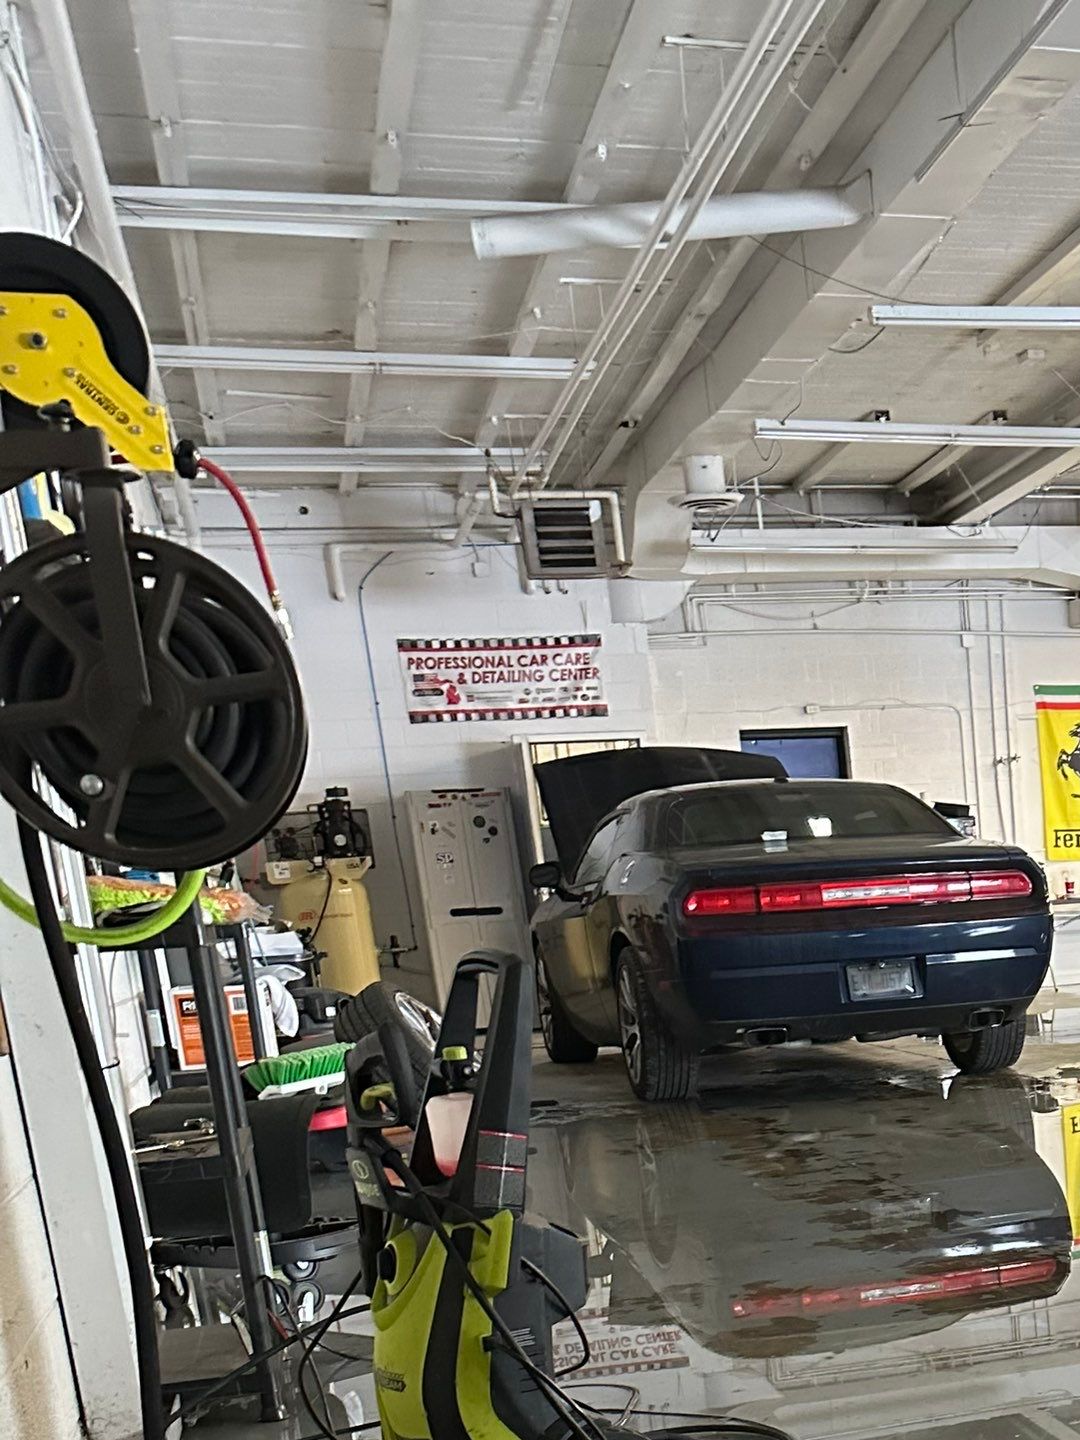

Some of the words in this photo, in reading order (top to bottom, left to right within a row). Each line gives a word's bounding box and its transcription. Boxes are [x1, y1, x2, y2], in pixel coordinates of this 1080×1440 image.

[75, 378, 117, 416] CENTRAL
[407, 655, 514, 670] PROFESSIONAL
[517, 653, 549, 667] CAR
[552, 652, 591, 666] CARE
[457, 673, 467, 685] &
[472, 669, 545, 684] DETAILING
[549, 667, 600, 682] CENTER
